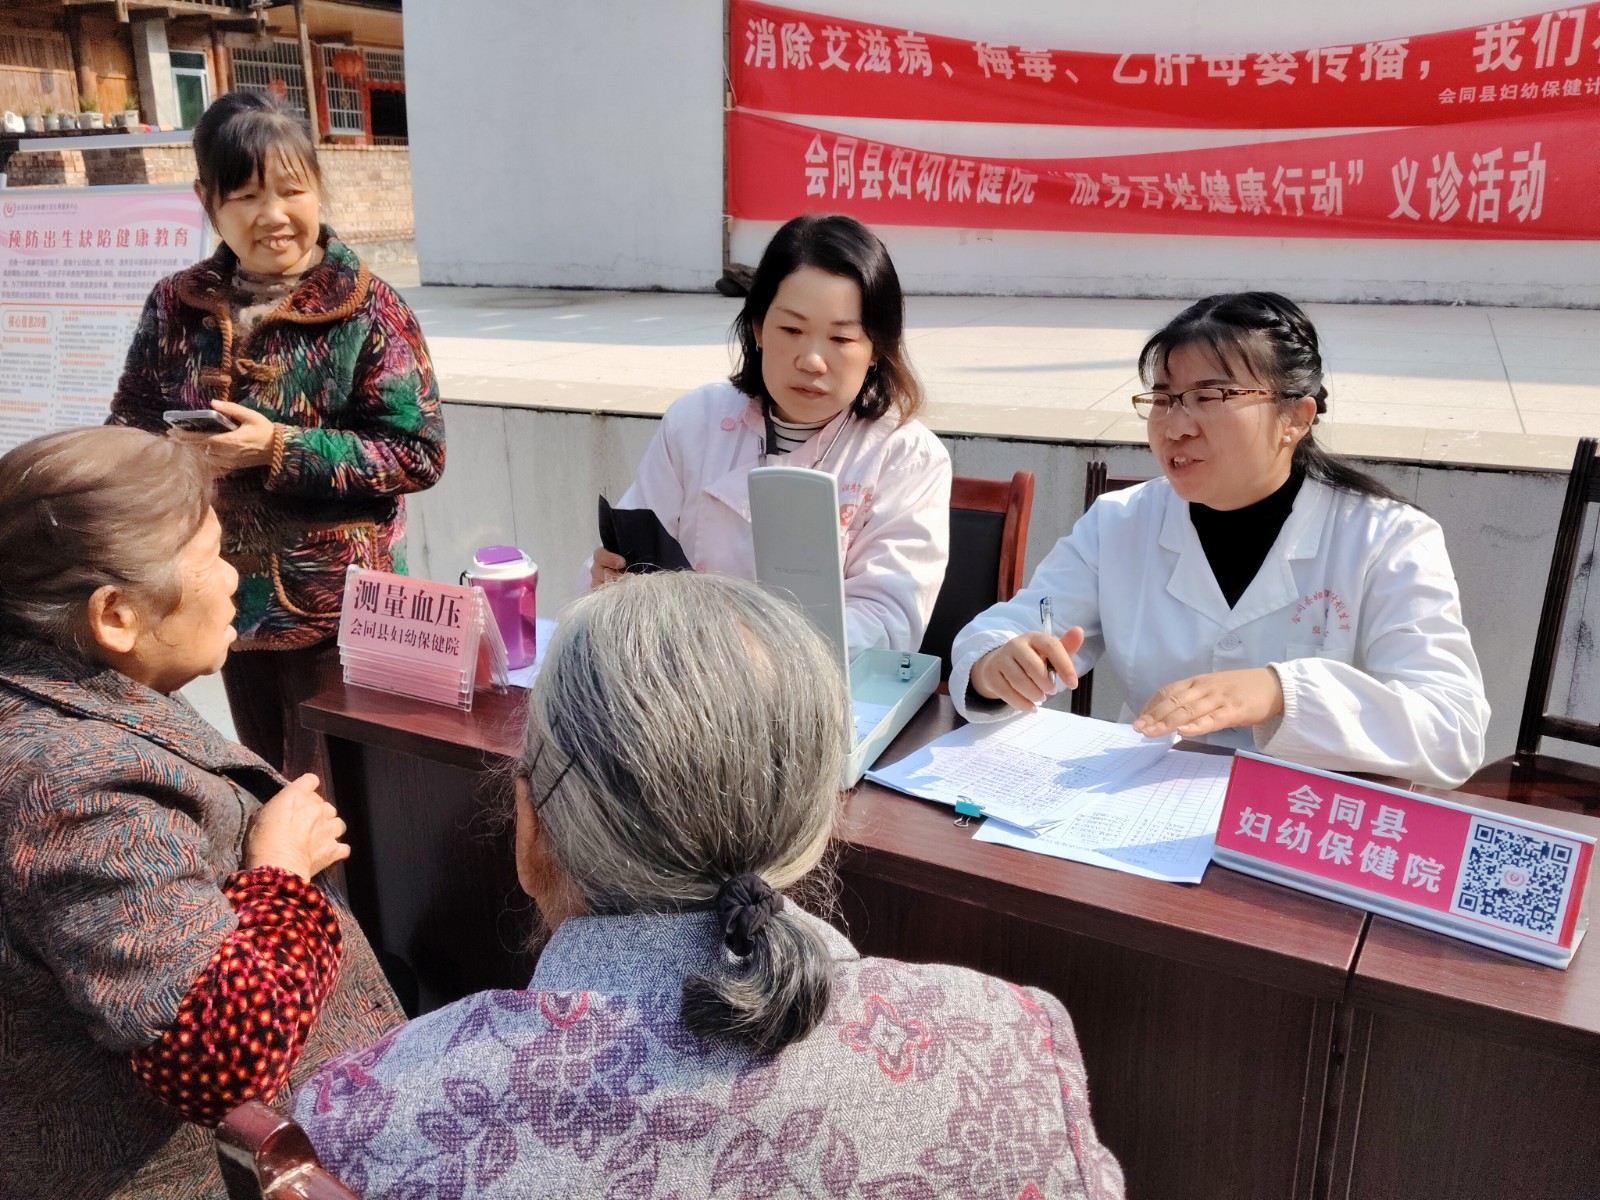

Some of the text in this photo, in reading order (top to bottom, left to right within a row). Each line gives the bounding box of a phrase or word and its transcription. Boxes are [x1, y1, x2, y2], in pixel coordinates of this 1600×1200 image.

[745, 9, 1600, 87] 消除艾滋病、梅毒、乙肝母婴传播，我们
[8, 227, 188, 249] 预防出生缺陷健康教育
[354, 579, 463, 629] 测量血压
[350, 618, 459, 656] 会同县妇幼保健院
[1287, 784, 1408, 842] 会同县
[1234, 807, 1446, 893] 妇幼保健院
